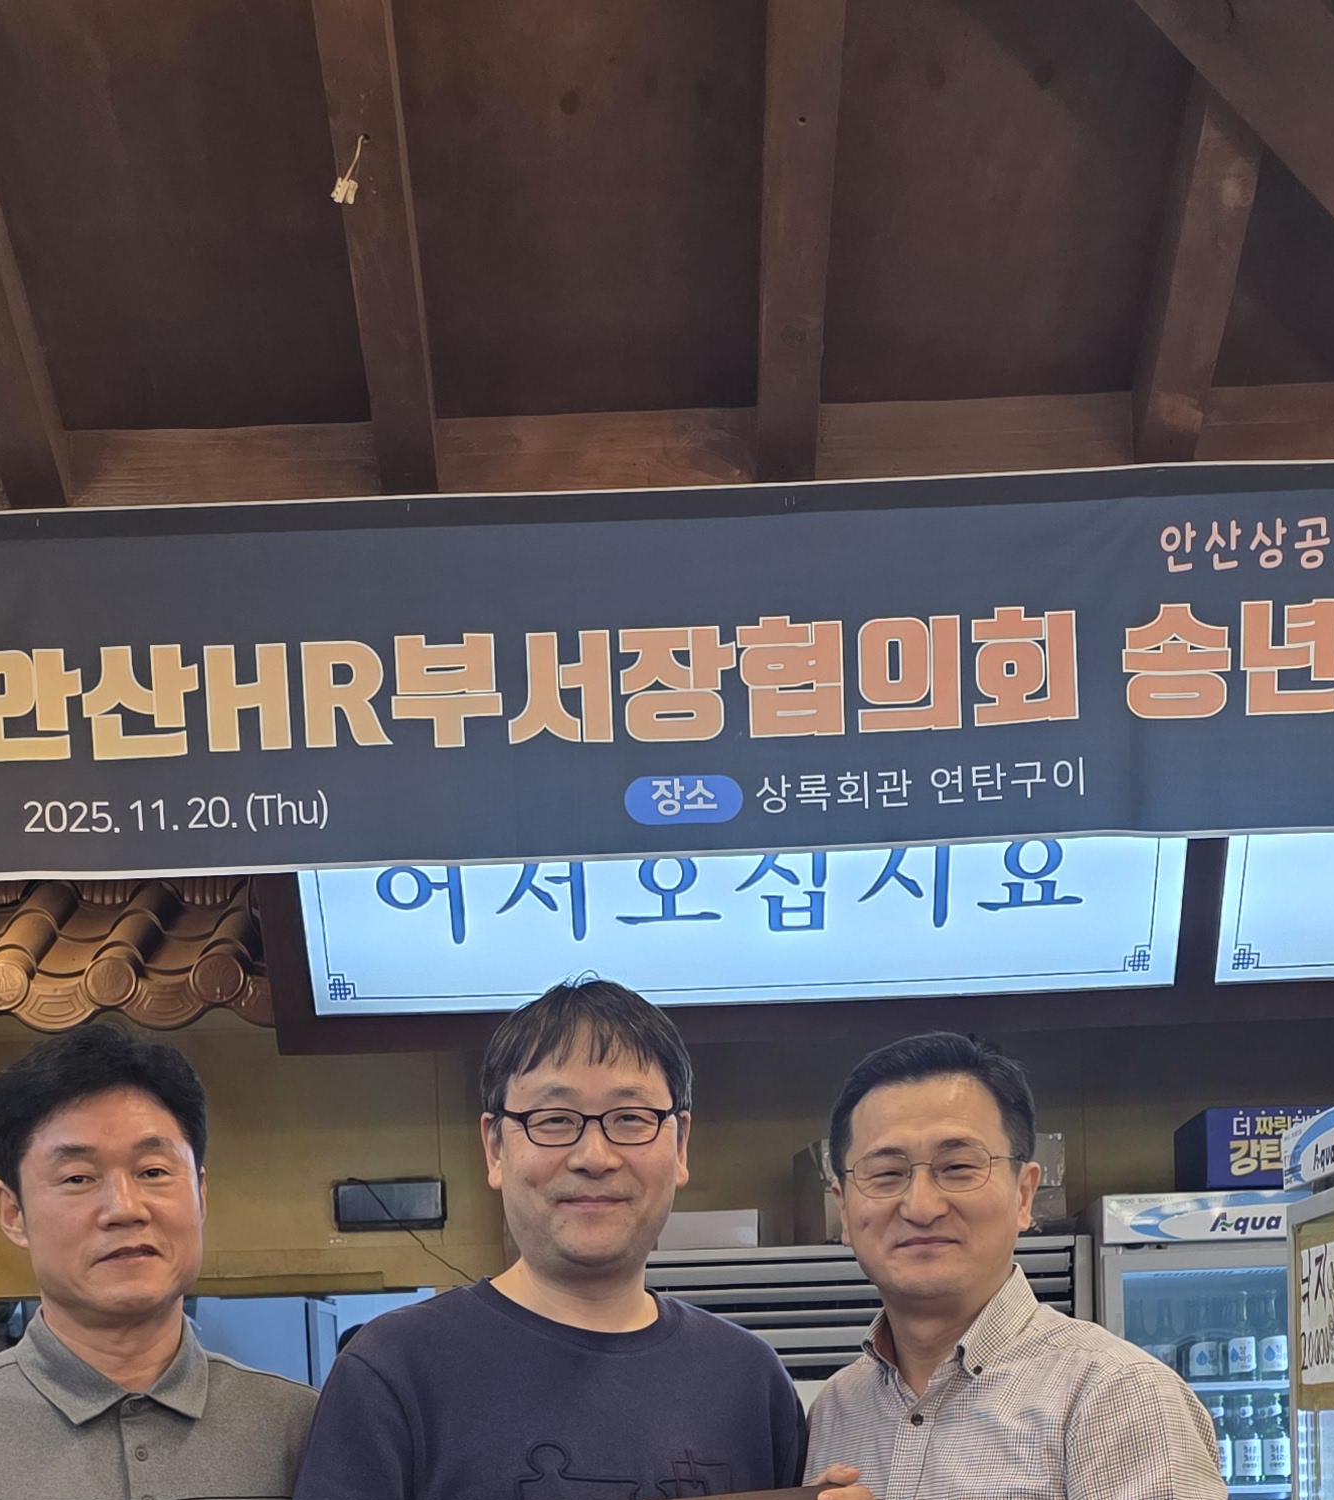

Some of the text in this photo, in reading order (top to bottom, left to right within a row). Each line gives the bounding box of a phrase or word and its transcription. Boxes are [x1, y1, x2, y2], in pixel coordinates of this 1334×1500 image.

[651, 756, 1089, 817] 장소 상록회관 연탄구이
[23, 799, 121, 834] 2025.
[129, 798, 180, 833] 11.
[1233, 1116, 1251, 1136] 더
[1209, 1212, 1283, 1236] Aqua
